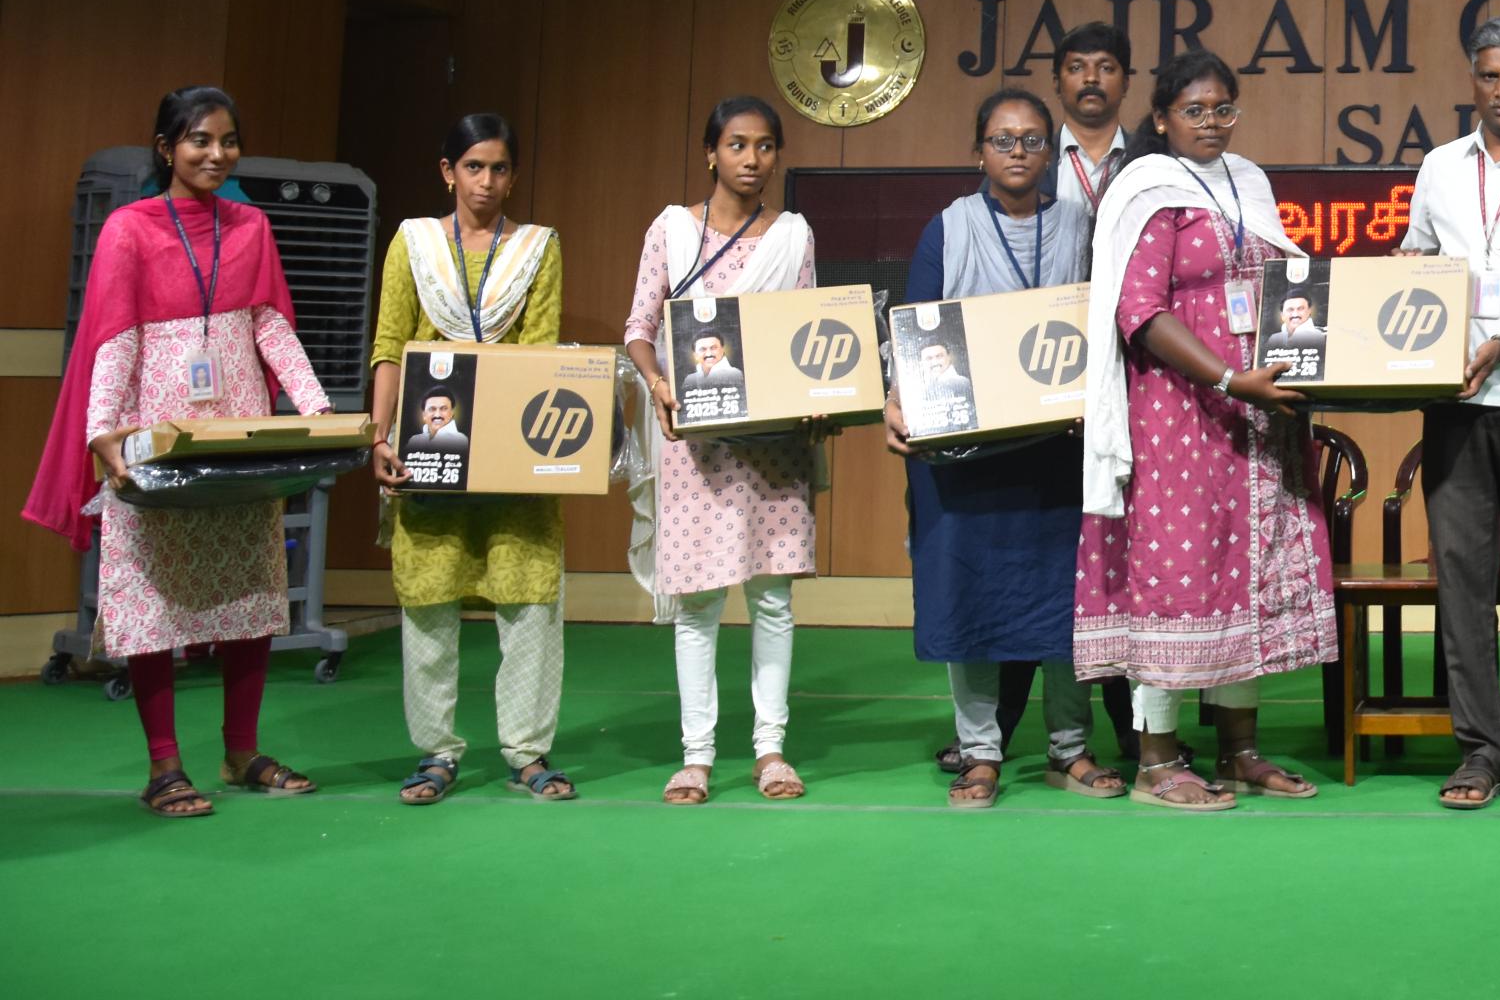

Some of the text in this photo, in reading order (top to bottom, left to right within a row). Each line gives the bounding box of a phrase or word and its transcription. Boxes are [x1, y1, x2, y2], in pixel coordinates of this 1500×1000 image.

[786, 81, 818, 112] BUILDS
[799, 318, 854, 381] hp
[1384, 287, 1442, 351] hp
[1028, 320, 1082, 386] hp
[1266, 362, 1318, 376] 5-26
[528, 388, 588, 458] hp
[686, 400, 739, 418] 2025-26
